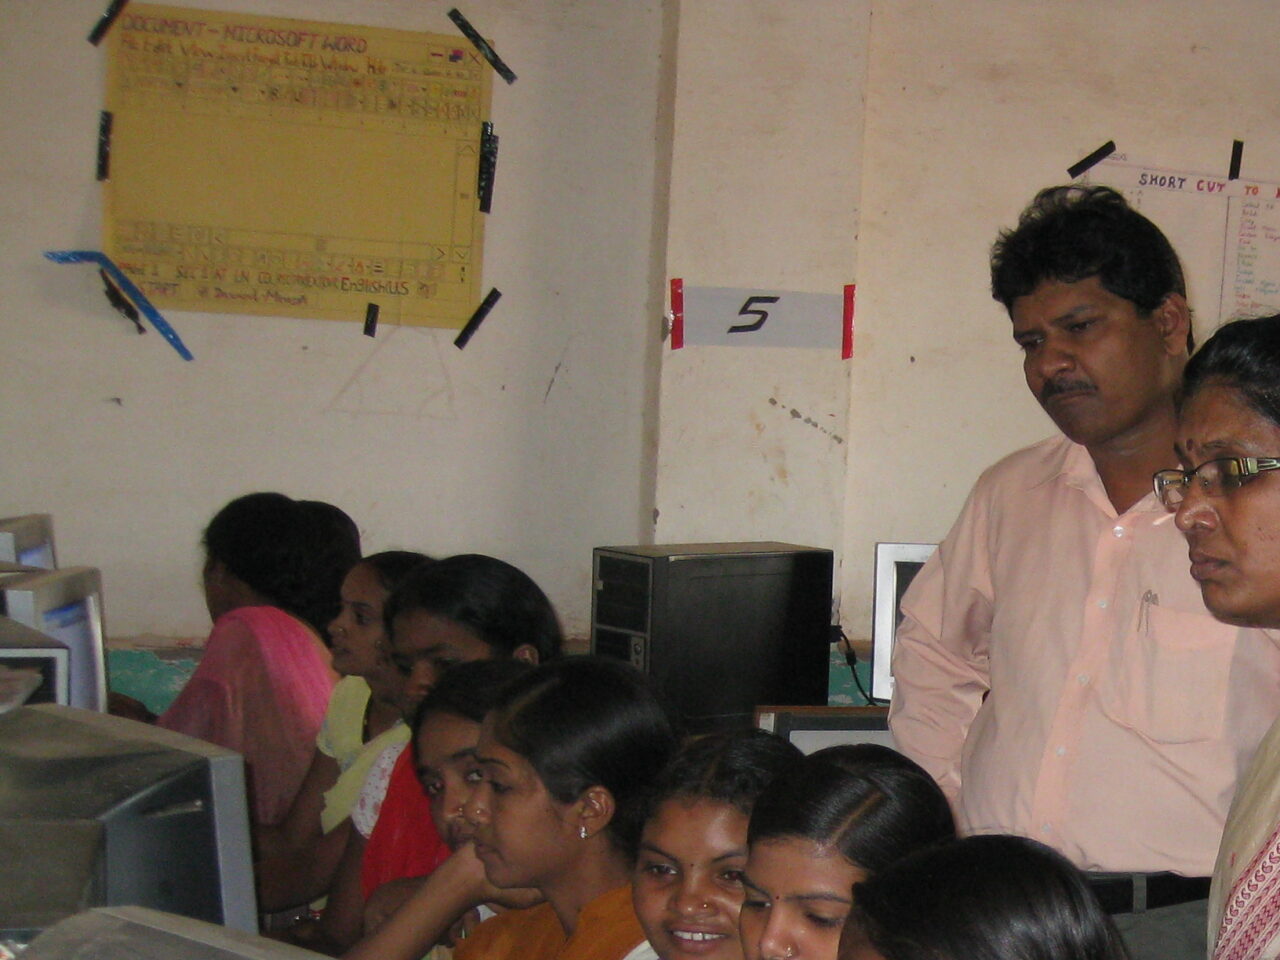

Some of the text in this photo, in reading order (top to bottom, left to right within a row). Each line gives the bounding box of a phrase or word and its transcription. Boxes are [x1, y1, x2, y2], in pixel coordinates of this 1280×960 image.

[120, 14, 206, 36] DOCUMENT
[223, 25, 320, 49] MICROSOFT
[321, 34, 368, 54] WORD
[1138, 172, 1187, 190] SHORT
[1196, 179, 1227, 193] CUT
[1243, 184, 1259, 197] TO
[727, 296, 780, 334] 5
